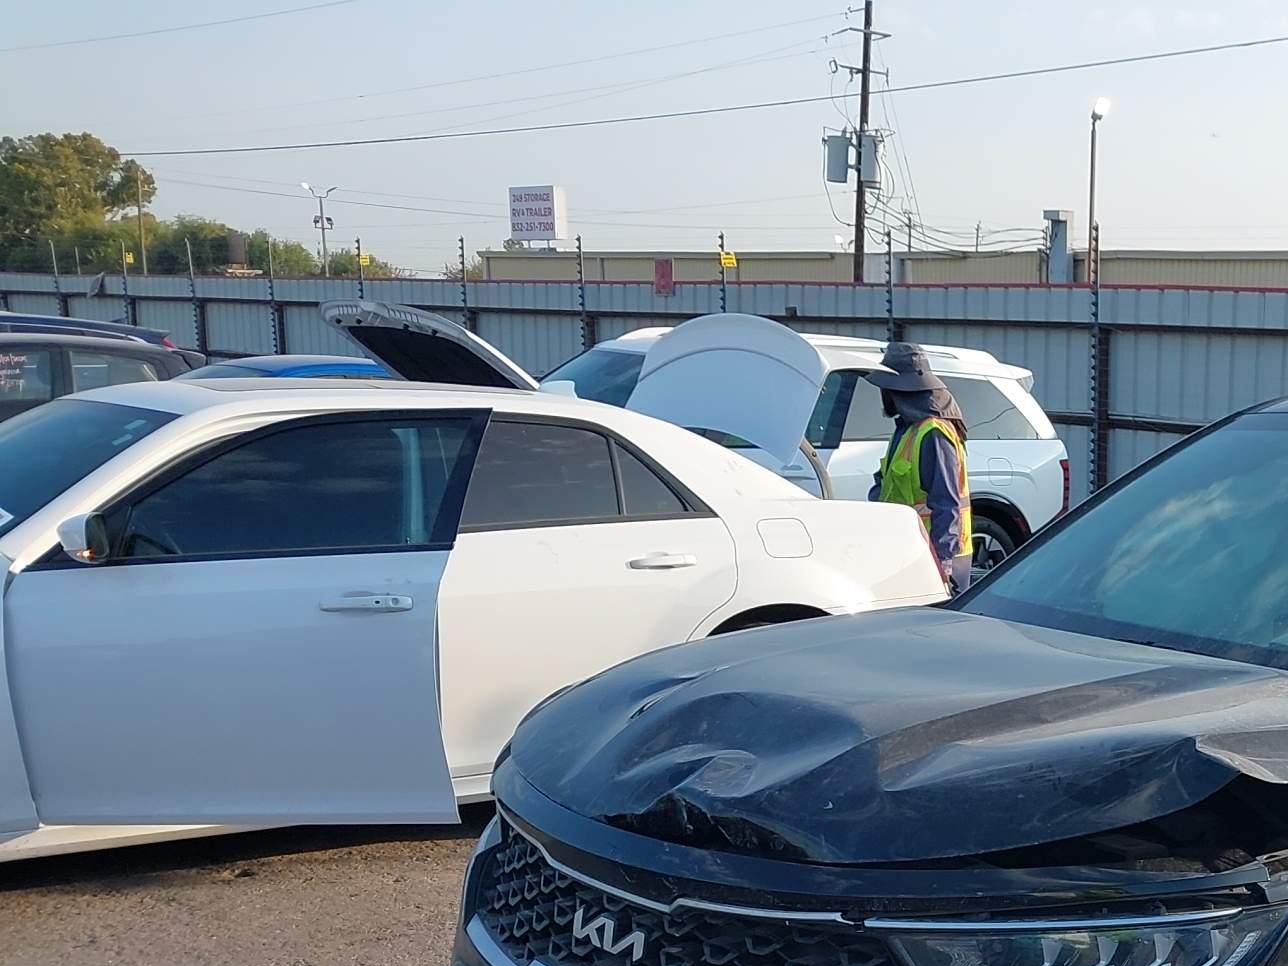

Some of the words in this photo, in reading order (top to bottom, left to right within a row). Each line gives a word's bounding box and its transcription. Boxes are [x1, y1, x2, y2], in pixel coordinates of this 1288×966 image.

[523, 193, 551, 202] STORAGE
[526, 207, 552, 217] TRAILER
[572, 908, 645, 962] KIA
